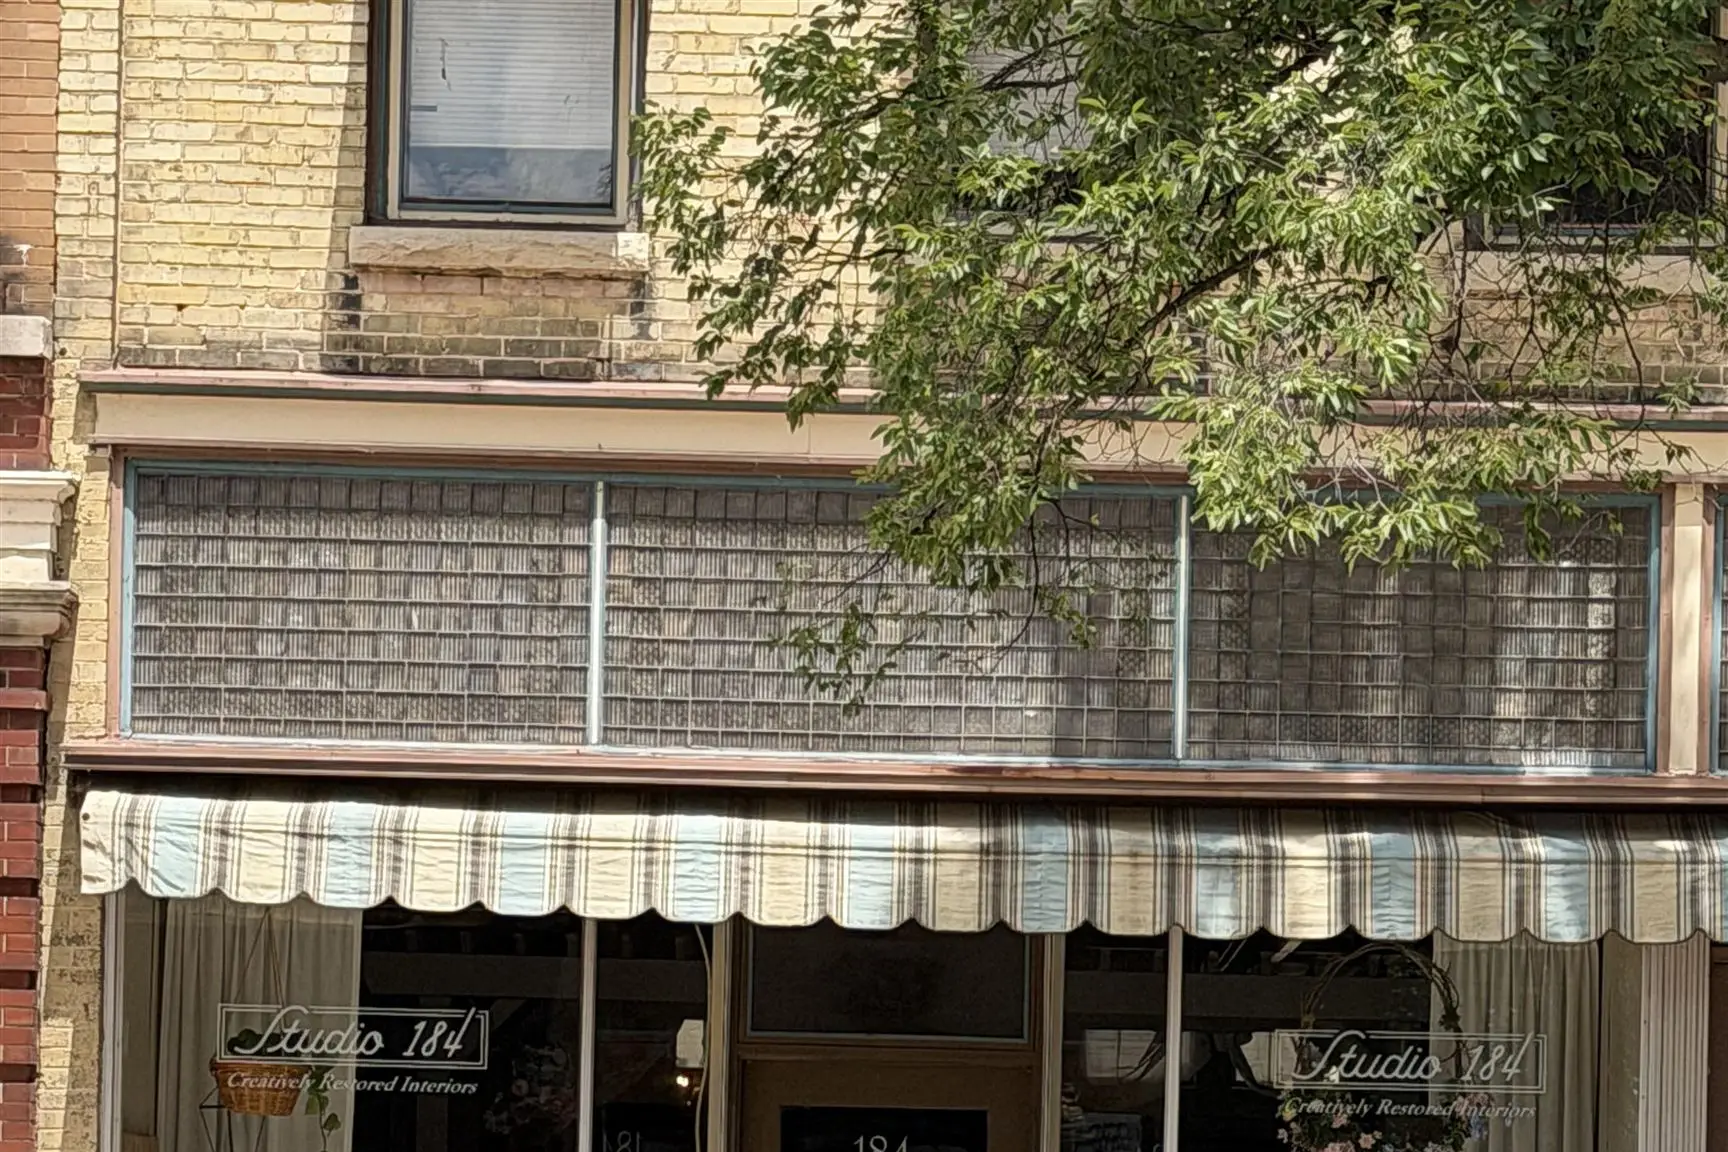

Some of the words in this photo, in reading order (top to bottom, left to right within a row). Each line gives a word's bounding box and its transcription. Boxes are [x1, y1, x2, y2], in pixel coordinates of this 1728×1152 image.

[234, 1005, 384, 1057] Studio
[402, 1006, 477, 1057] 184
[1291, 1030, 1442, 1081] Studio
[1460, 1031, 1536, 1082] 184
[227, 1072, 313, 1092] Creatively
[318, 1073, 400, 1092] Restored
[400, 1075, 480, 1095] Interiors
[1285, 1097, 1372, 1118] Creatively
[1375, 1098, 1454, 1117] Restored
[1458, 1100, 1537, 1118] Interiors
